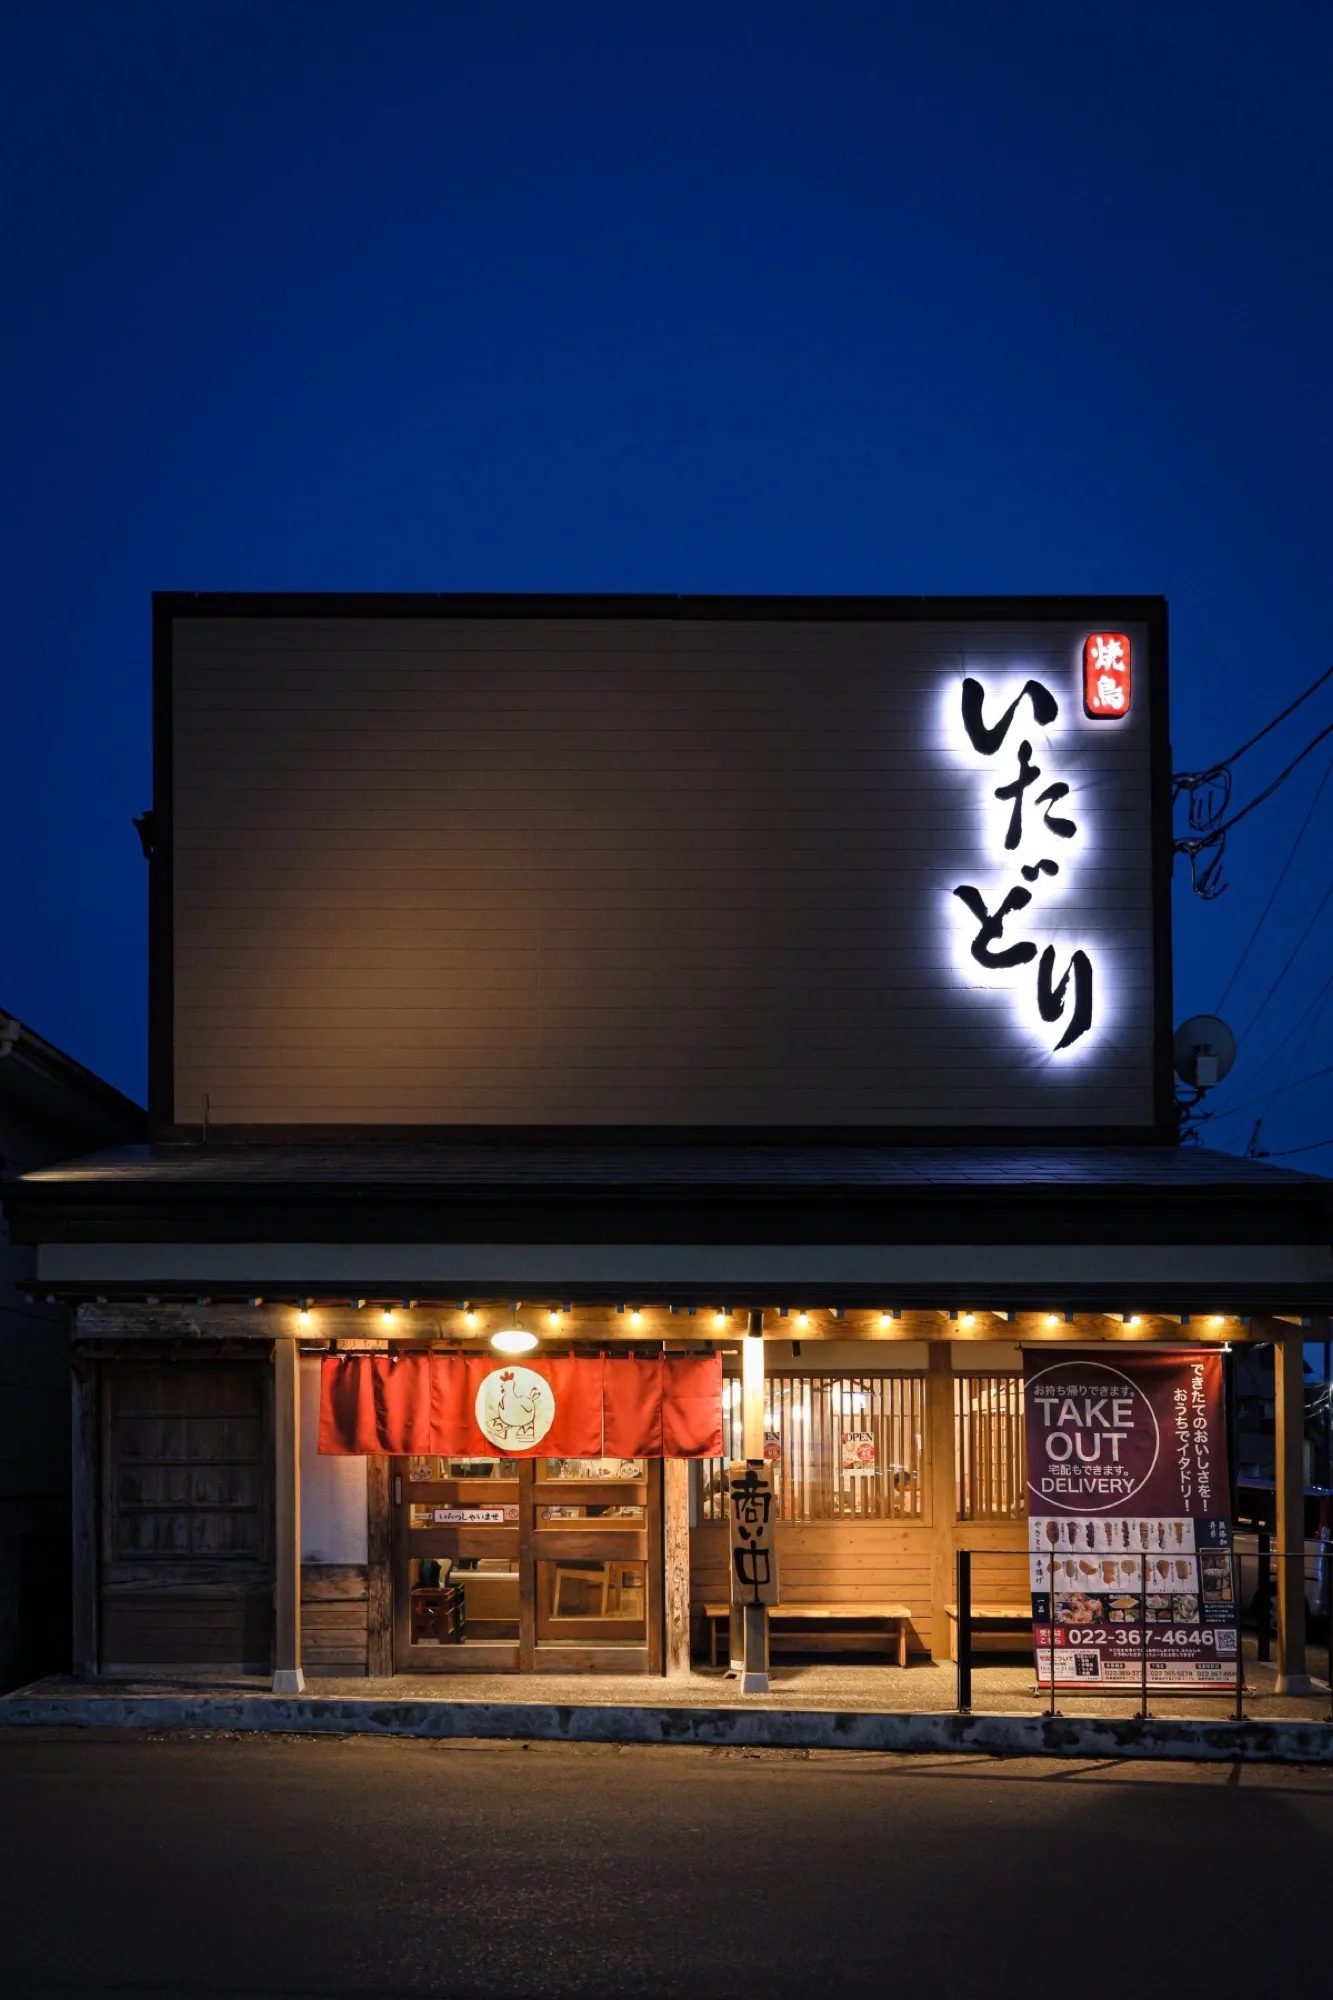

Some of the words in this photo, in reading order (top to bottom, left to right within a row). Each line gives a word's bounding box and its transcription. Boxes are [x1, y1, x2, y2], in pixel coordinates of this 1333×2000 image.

[1091, 637, 1125, 710] 焼鳥
[953, 677, 1093, 1051] いたどり
[1034, 1385, 1135, 1397] お持ち帰りできます。
[1034, 1398, 1135, 1428] TAKE
[847, 1432, 873, 1442] OPEN
[1045, 1432, 1128, 1462] OUT
[1173, 1388, 1192, 1512] おうちでイタドリ！
[1191, 1363, 1211, 1512] できたてのおいしさを！
[1048, 1464, 1129, 1476] 宅配もできます。
[1041, 1478, 1135, 1493] DELIVERY
[439, 1512, 500, 1521] いらっしゃいませ
[731, 1470, 772, 1602] 商い中
[1068, 1629, 1214, 1645] 022-367-4646
